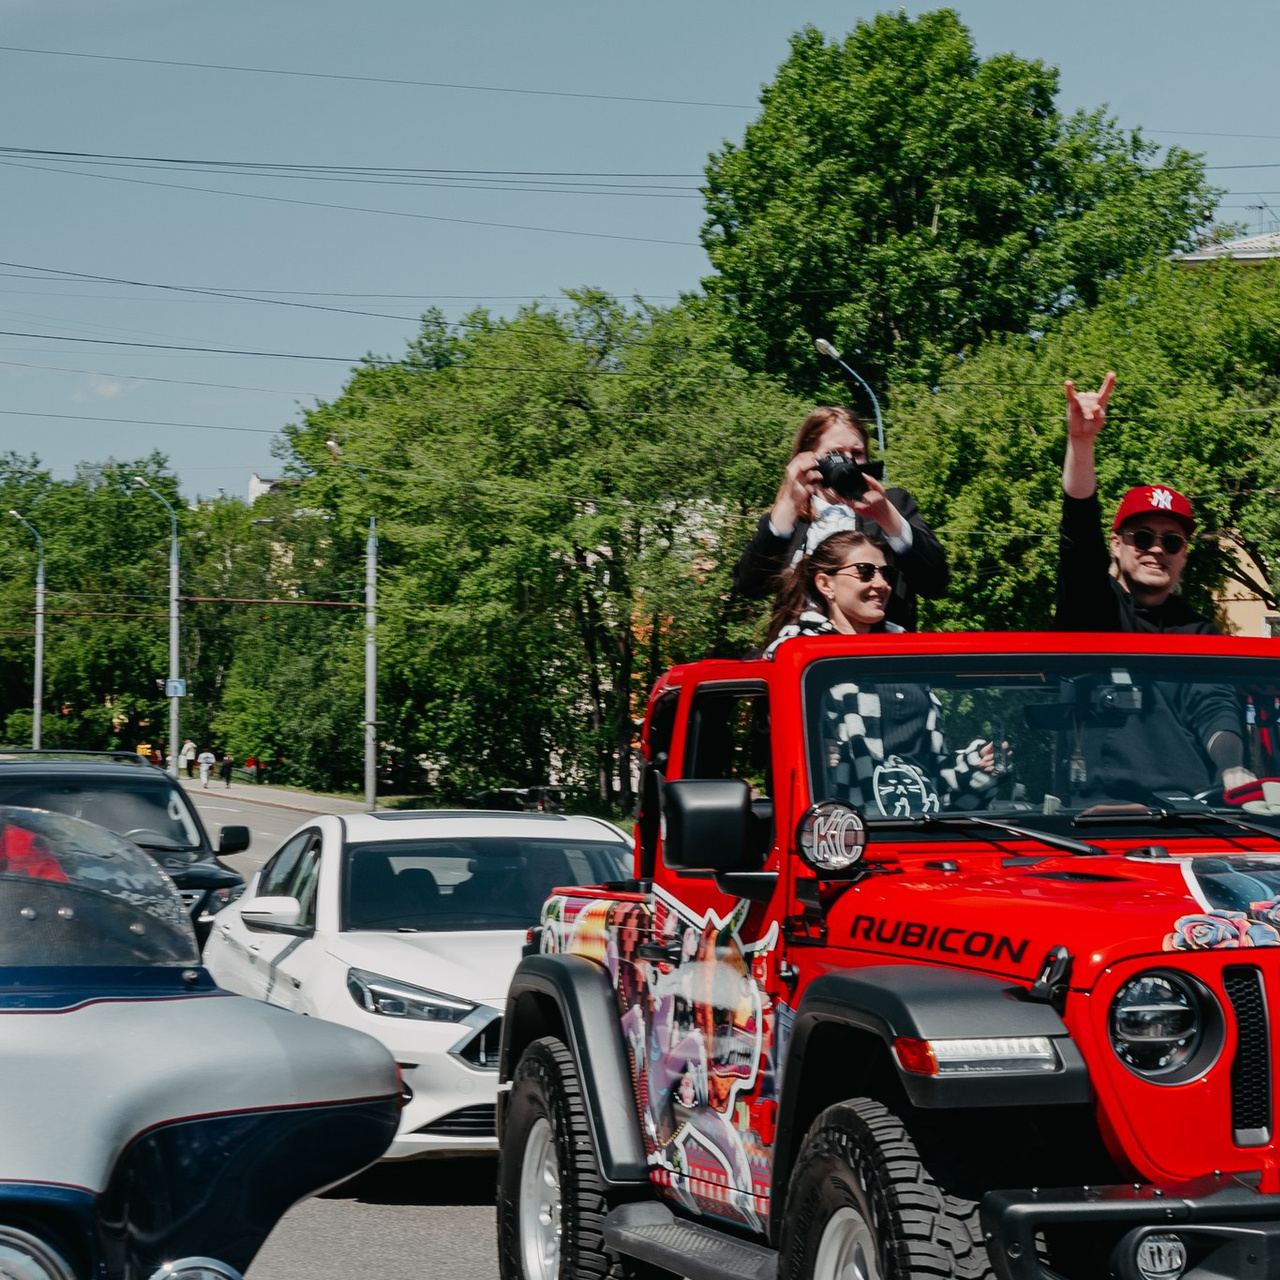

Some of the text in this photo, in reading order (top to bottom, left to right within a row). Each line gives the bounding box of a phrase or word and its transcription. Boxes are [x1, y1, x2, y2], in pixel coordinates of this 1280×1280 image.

[1151, 488, 1173, 510] NY
[812, 809, 864, 865] KC
[849, 914, 1031, 964] RUBICON
